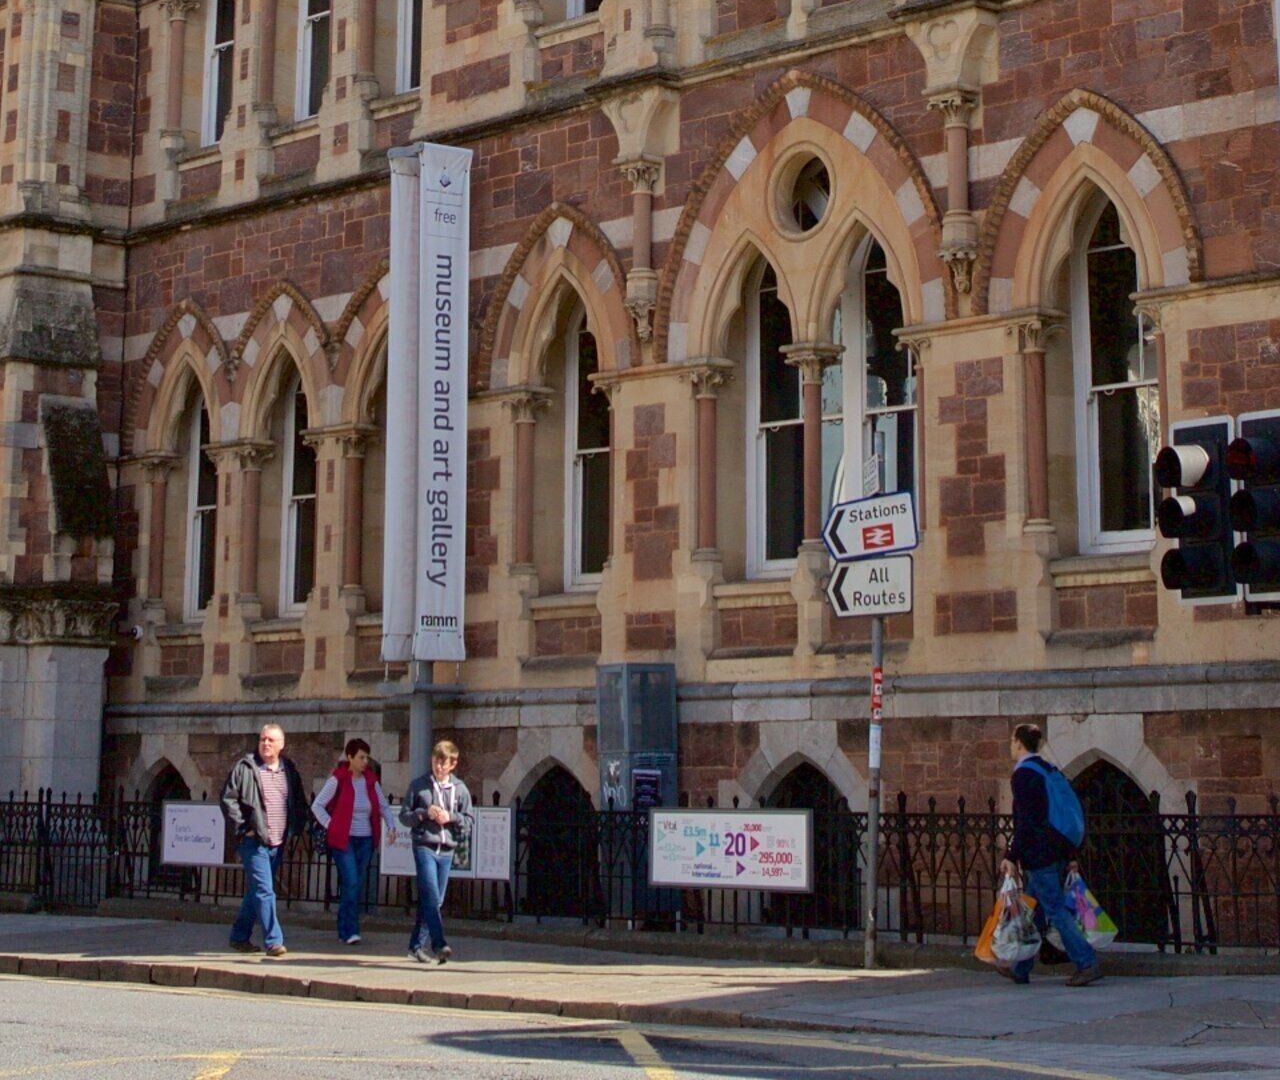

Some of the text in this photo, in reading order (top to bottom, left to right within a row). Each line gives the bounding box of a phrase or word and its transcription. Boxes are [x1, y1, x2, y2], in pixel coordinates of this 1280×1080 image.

[433, 207, 458, 226] free
[434, 254, 453, 372] museum
[432, 380, 455, 432] and
[432, 439, 454, 482] art
[848, 502, 908, 524] Stations
[425, 489, 454, 589] gallery
[868, 567, 890, 584] All
[852, 590, 907, 607] Routes
[420, 614, 458, 628] ramm
[724, 832, 746, 857] 20
[758, 851, 793, 866] 295,000
